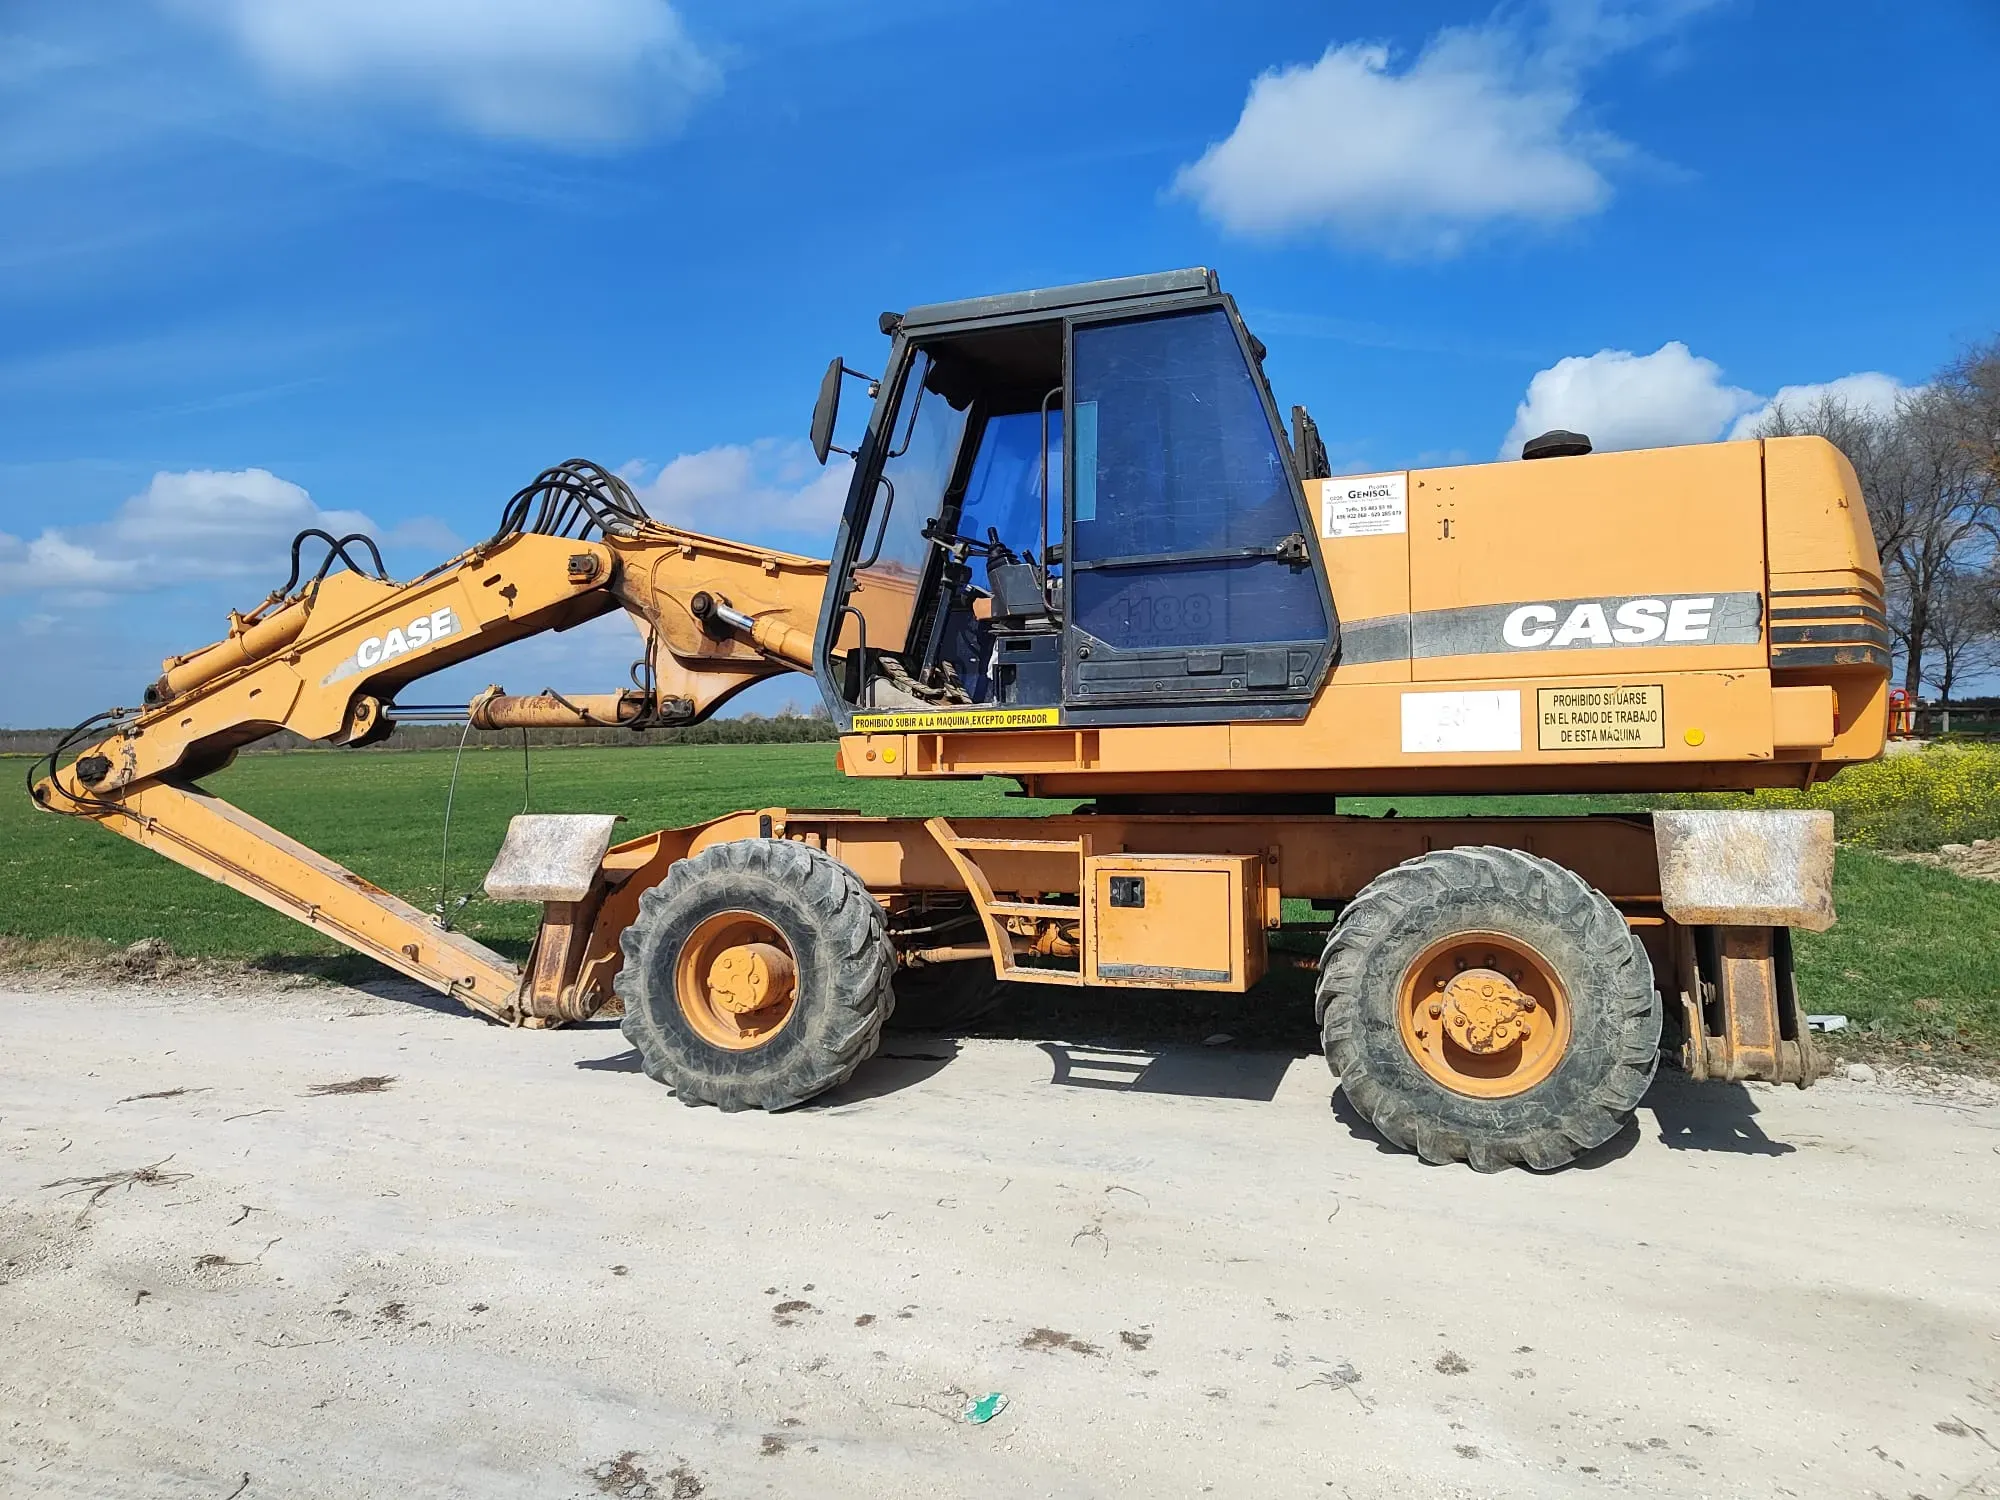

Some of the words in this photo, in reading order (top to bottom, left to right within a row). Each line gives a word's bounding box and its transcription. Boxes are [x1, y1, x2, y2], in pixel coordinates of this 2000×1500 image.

[1347, 489, 1392, 499] GENISOL
[1108, 593, 1211, 634] 1188
[1502, 597, 1715, 648] CASE
[356, 606, 452, 668] CASE
[1553, 693, 1601, 707] PROHIBIDO
[855, 718, 894, 729] PROHIBIDO
[895, 717, 917, 728] SUBIR
[918, 717, 924, 727] A
[925, 717, 935, 727] LA
[1006, 713, 1048, 725] OPERADOR
[1544, 712, 1556, 725] EN
[1558, 712, 1569, 725] EL
[1571, 711, 1599, 724] RADIO
[1601, 711, 1613, 724] DE
[1615, 710, 1658, 724] TRABAJO
[1560, 730, 1573, 743] DE
[1574, 729, 1598, 743] ESTA
[1600, 726, 1641, 743] MÁQUINA
[1131, 965, 1183, 980] CASE
